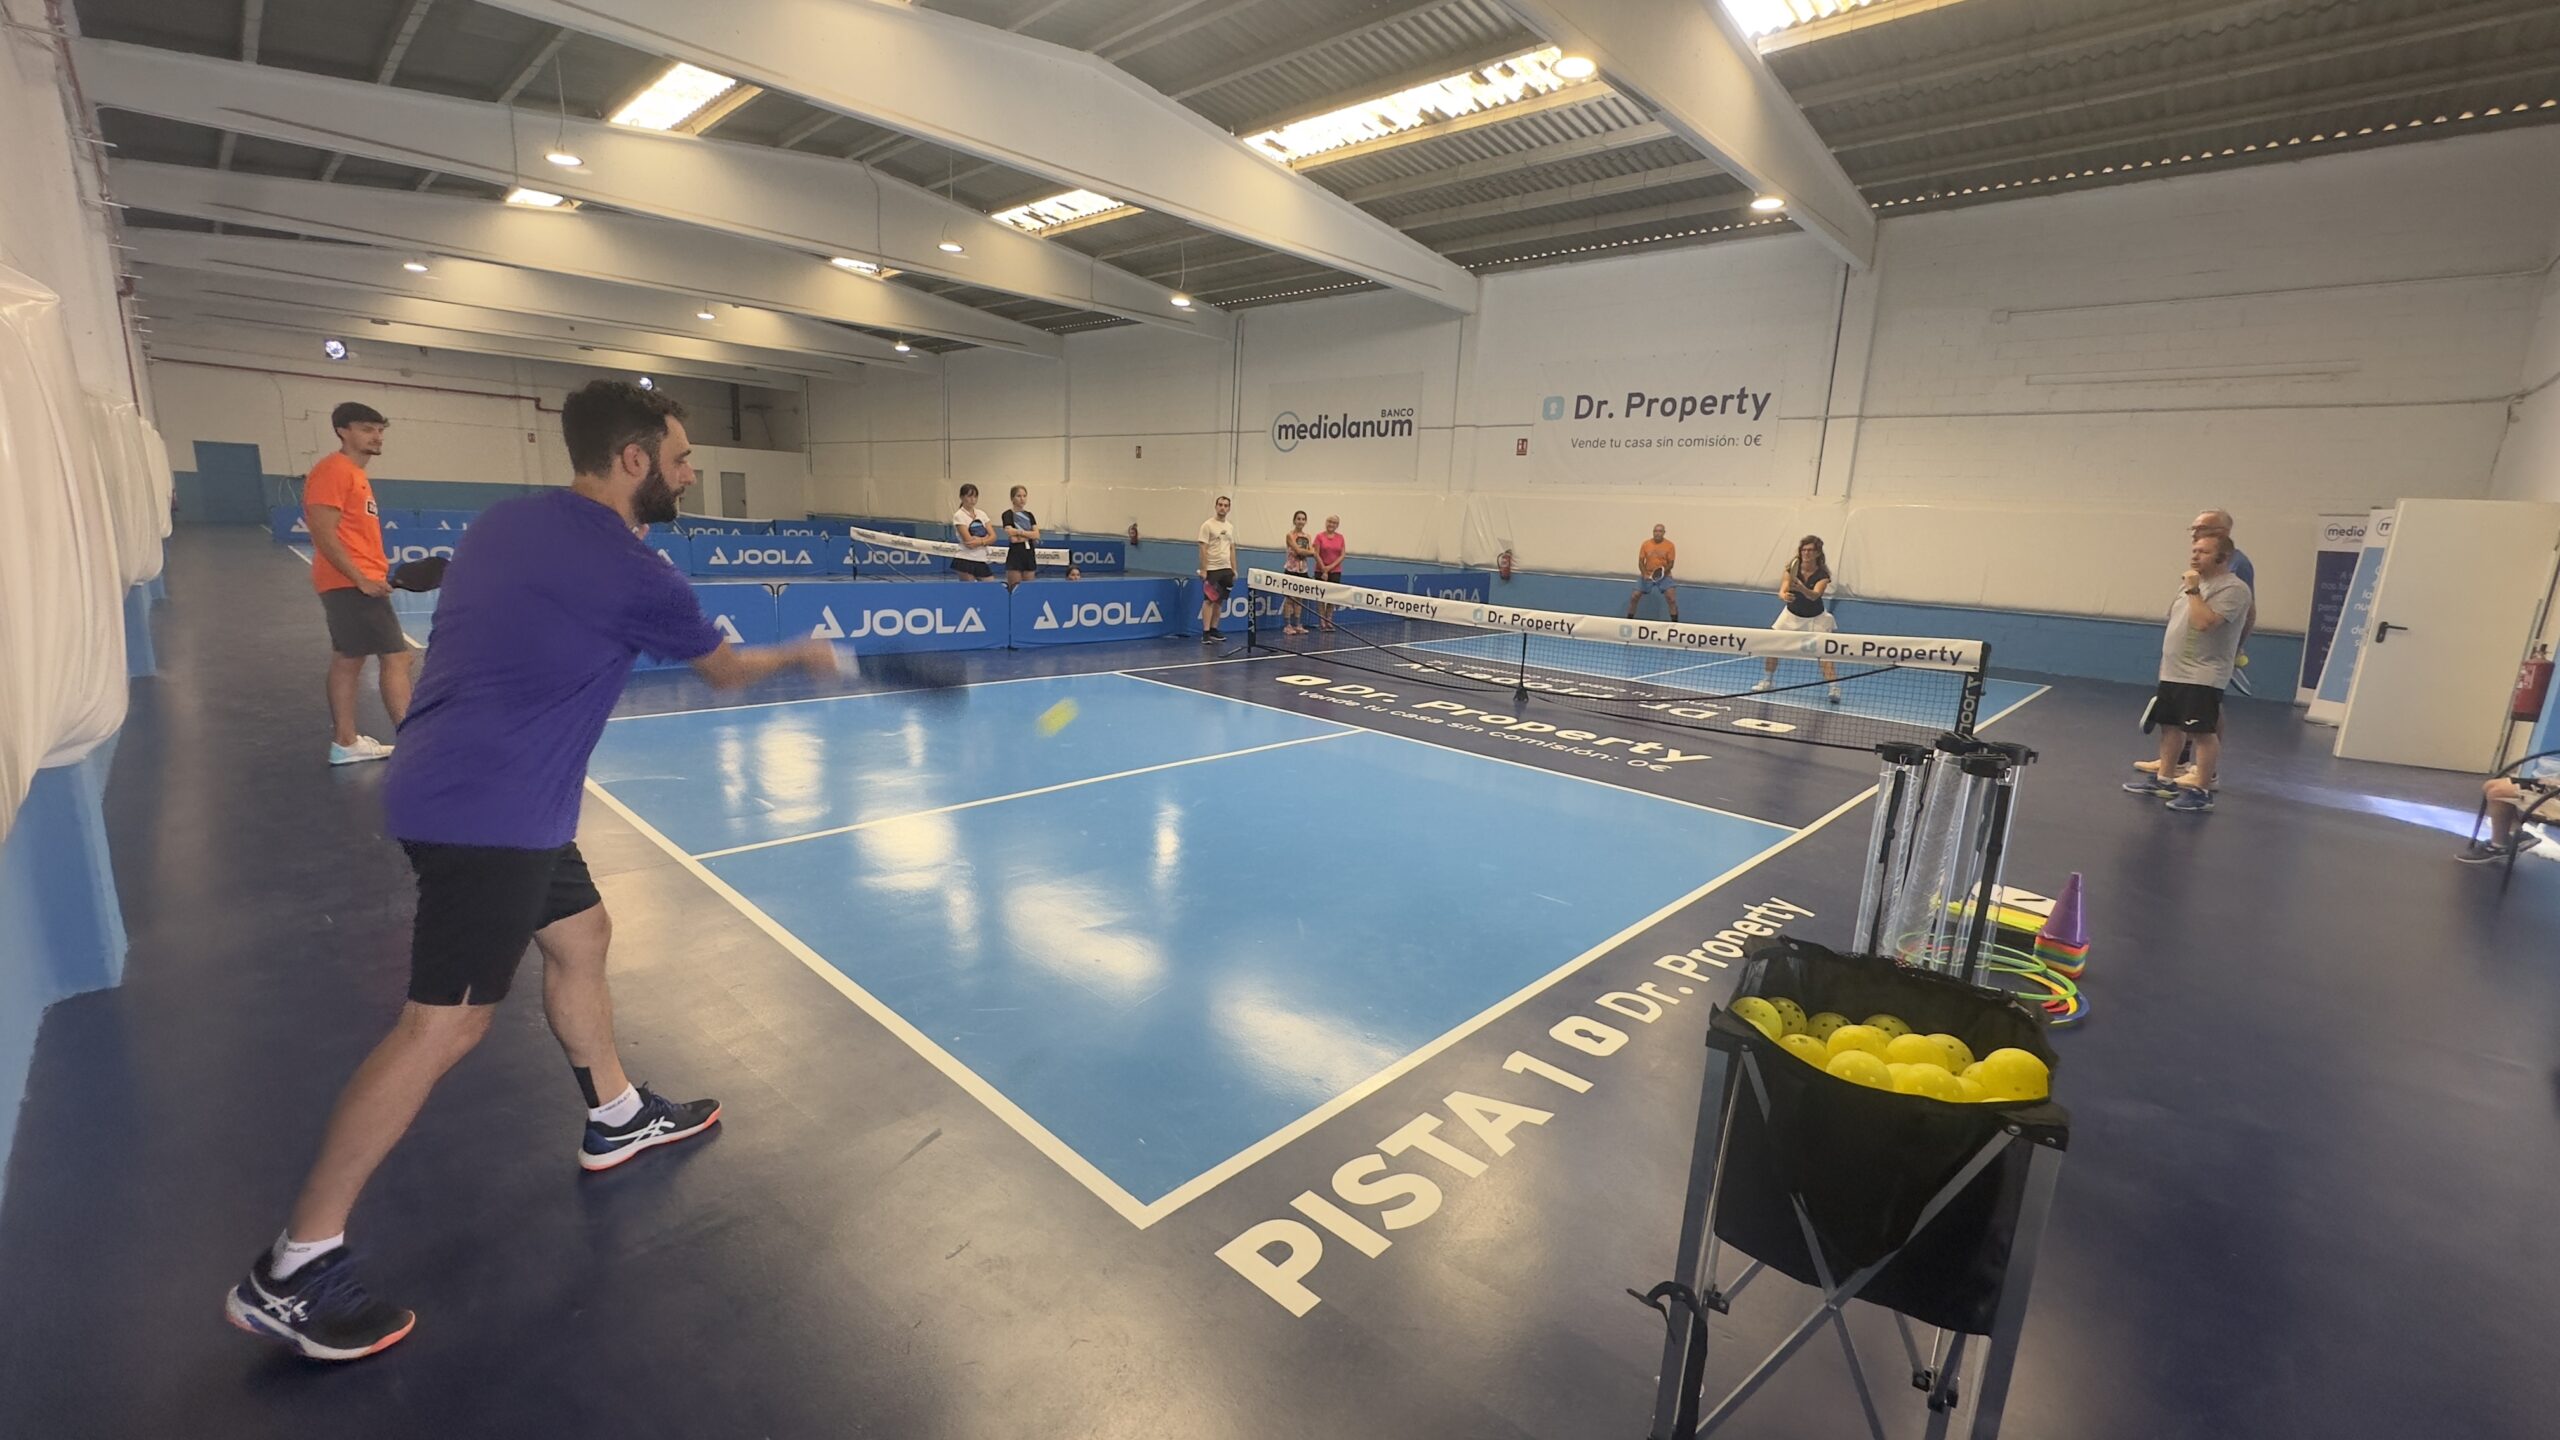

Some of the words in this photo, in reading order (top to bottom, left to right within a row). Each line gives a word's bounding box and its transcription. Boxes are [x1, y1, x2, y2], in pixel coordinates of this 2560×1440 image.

[1381, 408, 1414, 418] BANCO
[1574, 394, 1614, 420] Dr.
[1625, 386, 1771, 422] Property
[1277, 413, 1413, 440] mediolanum
[1571, 437, 1607, 449] Vende
[1610, 438, 1621, 448] tu
[1624, 438, 1652, 448] casa
[1656, 436, 1674, 448] sin
[1677, 435, 1739, 448] comisión:
[1743, 434, 1762, 447] 0€
[731, 549, 813, 565] JOOLA
[862, 550, 931, 564] JOOLA
[1072, 552, 1115, 564] OOLA
[1265, 575, 1280, 588] Dr.
[1282, 578, 1326, 598] Property
[1063, 601, 1163, 628] JOOLA
[1366, 594, 1382, 607] Dr.
[1385, 596, 1438, 617] Property
[850, 607, 986, 637] JOOLA
[1488, 611, 1507, 625] Dr.
[1511, 614, 1575, 634] Property
[1638, 626, 1662, 641] Dr.
[1667, 629, 1747, 651] Property
[1825, 639, 1854, 656] Dr.
[1862, 641, 1963, 665] Property
[1325, 684, 1399, 703] Dr.
[1411, 700, 1713, 763] Property
[1958, 690, 1977, 732] JOOL
[1298, 691, 1360, 707] Vende
[1363, 704, 1388, 712] tu
[1390, 710, 1444, 724] casa
[1447, 722, 1484, 733] sin
[1489, 731, 1619, 761] comisión:
[1627, 759, 1673, 773] 0€
[1595, 981, 1694, 1024] Dr.
[1214, 1091, 1555, 1318] PISTA
[1502, 1050, 1595, 1094] 1
